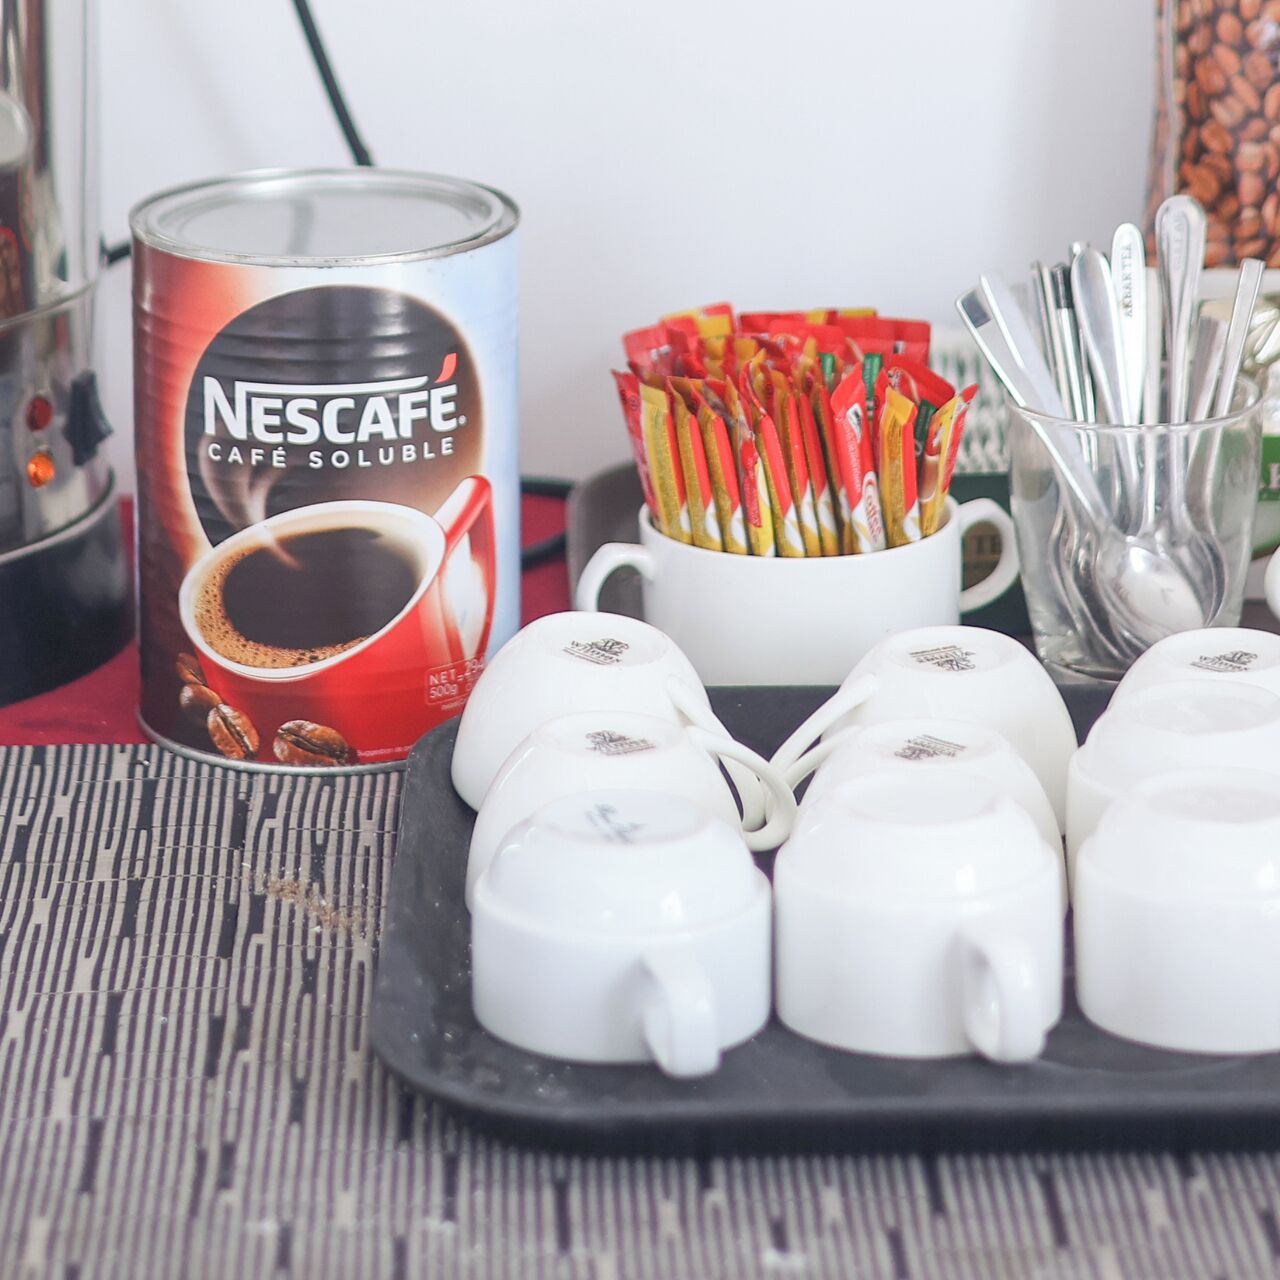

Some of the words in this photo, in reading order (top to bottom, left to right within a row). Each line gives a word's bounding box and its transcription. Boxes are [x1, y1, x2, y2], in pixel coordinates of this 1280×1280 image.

[203, 353, 458, 445] NESCAFÉ
[208, 444, 287, 469] CAFÉ
[308, 436, 455, 470] SOLUBLE
[429, 669, 456, 686] NET
[430, 683, 459, 699] 500g
